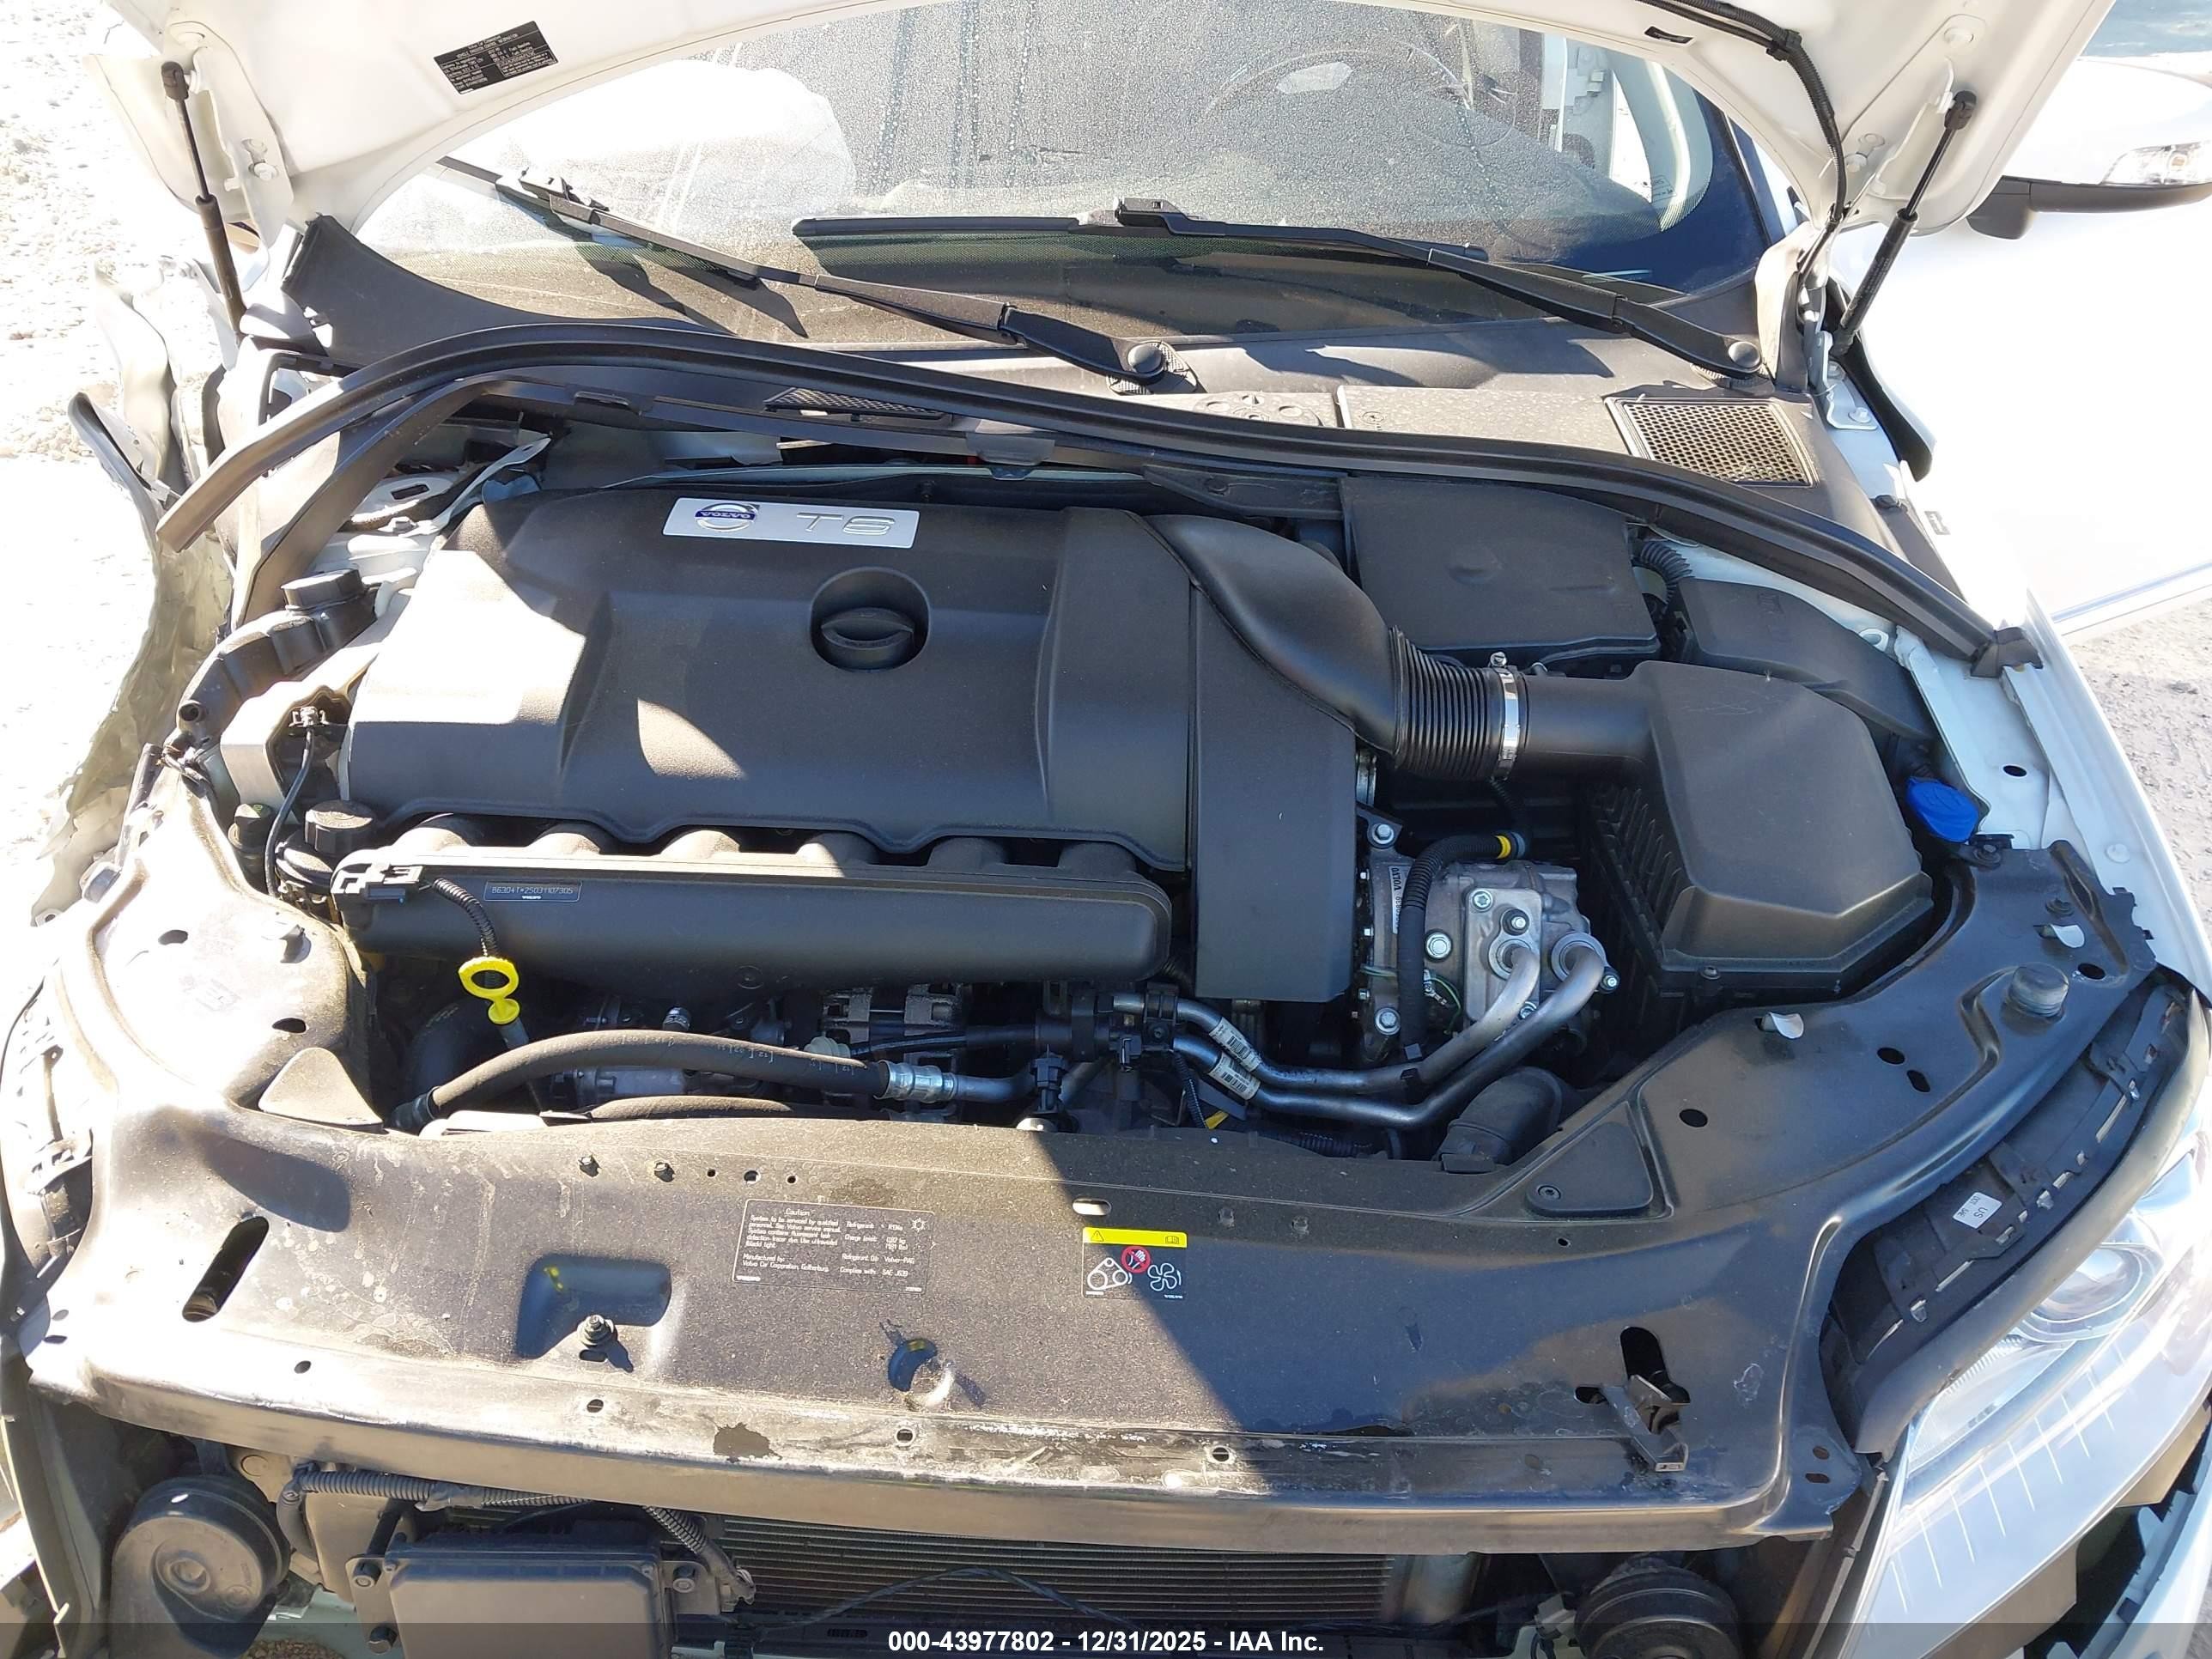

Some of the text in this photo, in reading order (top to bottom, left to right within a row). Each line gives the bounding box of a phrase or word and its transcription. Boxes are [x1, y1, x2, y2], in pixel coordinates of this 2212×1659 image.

[797, 512, 896, 536] T6
[1392, 867, 1402, 891] VOLVO
[785, 1208, 810, 1216] Caution
[1973, 1206, 1988, 1218] US
[743, 1253, 777, 1261] Manufactured
